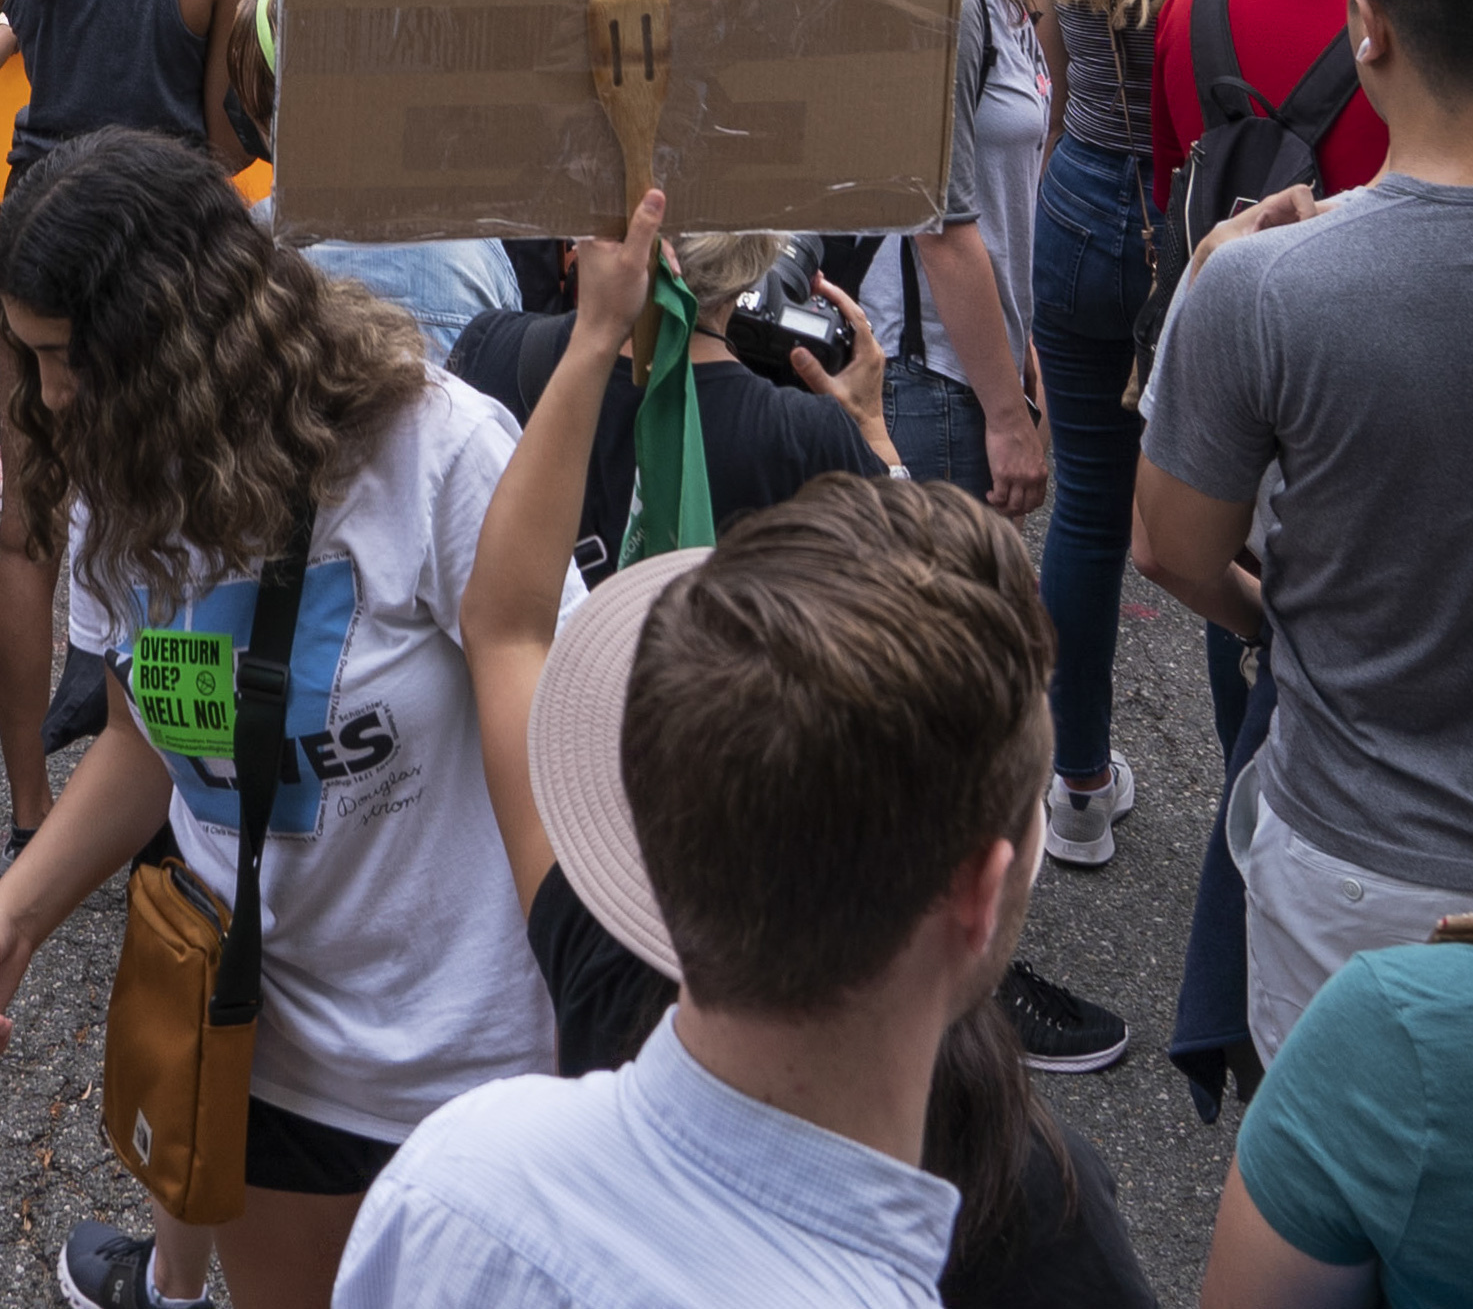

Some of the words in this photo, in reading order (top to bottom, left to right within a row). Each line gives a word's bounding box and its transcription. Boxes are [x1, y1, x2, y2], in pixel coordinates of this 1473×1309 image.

[140, 636, 220, 666] OVERTURN
[140, 665, 181, 692] ROE?
[143, 696, 191, 729] HELL
[193, 700, 230, 732] NO!
[336, 764, 423, 819] Douglas
